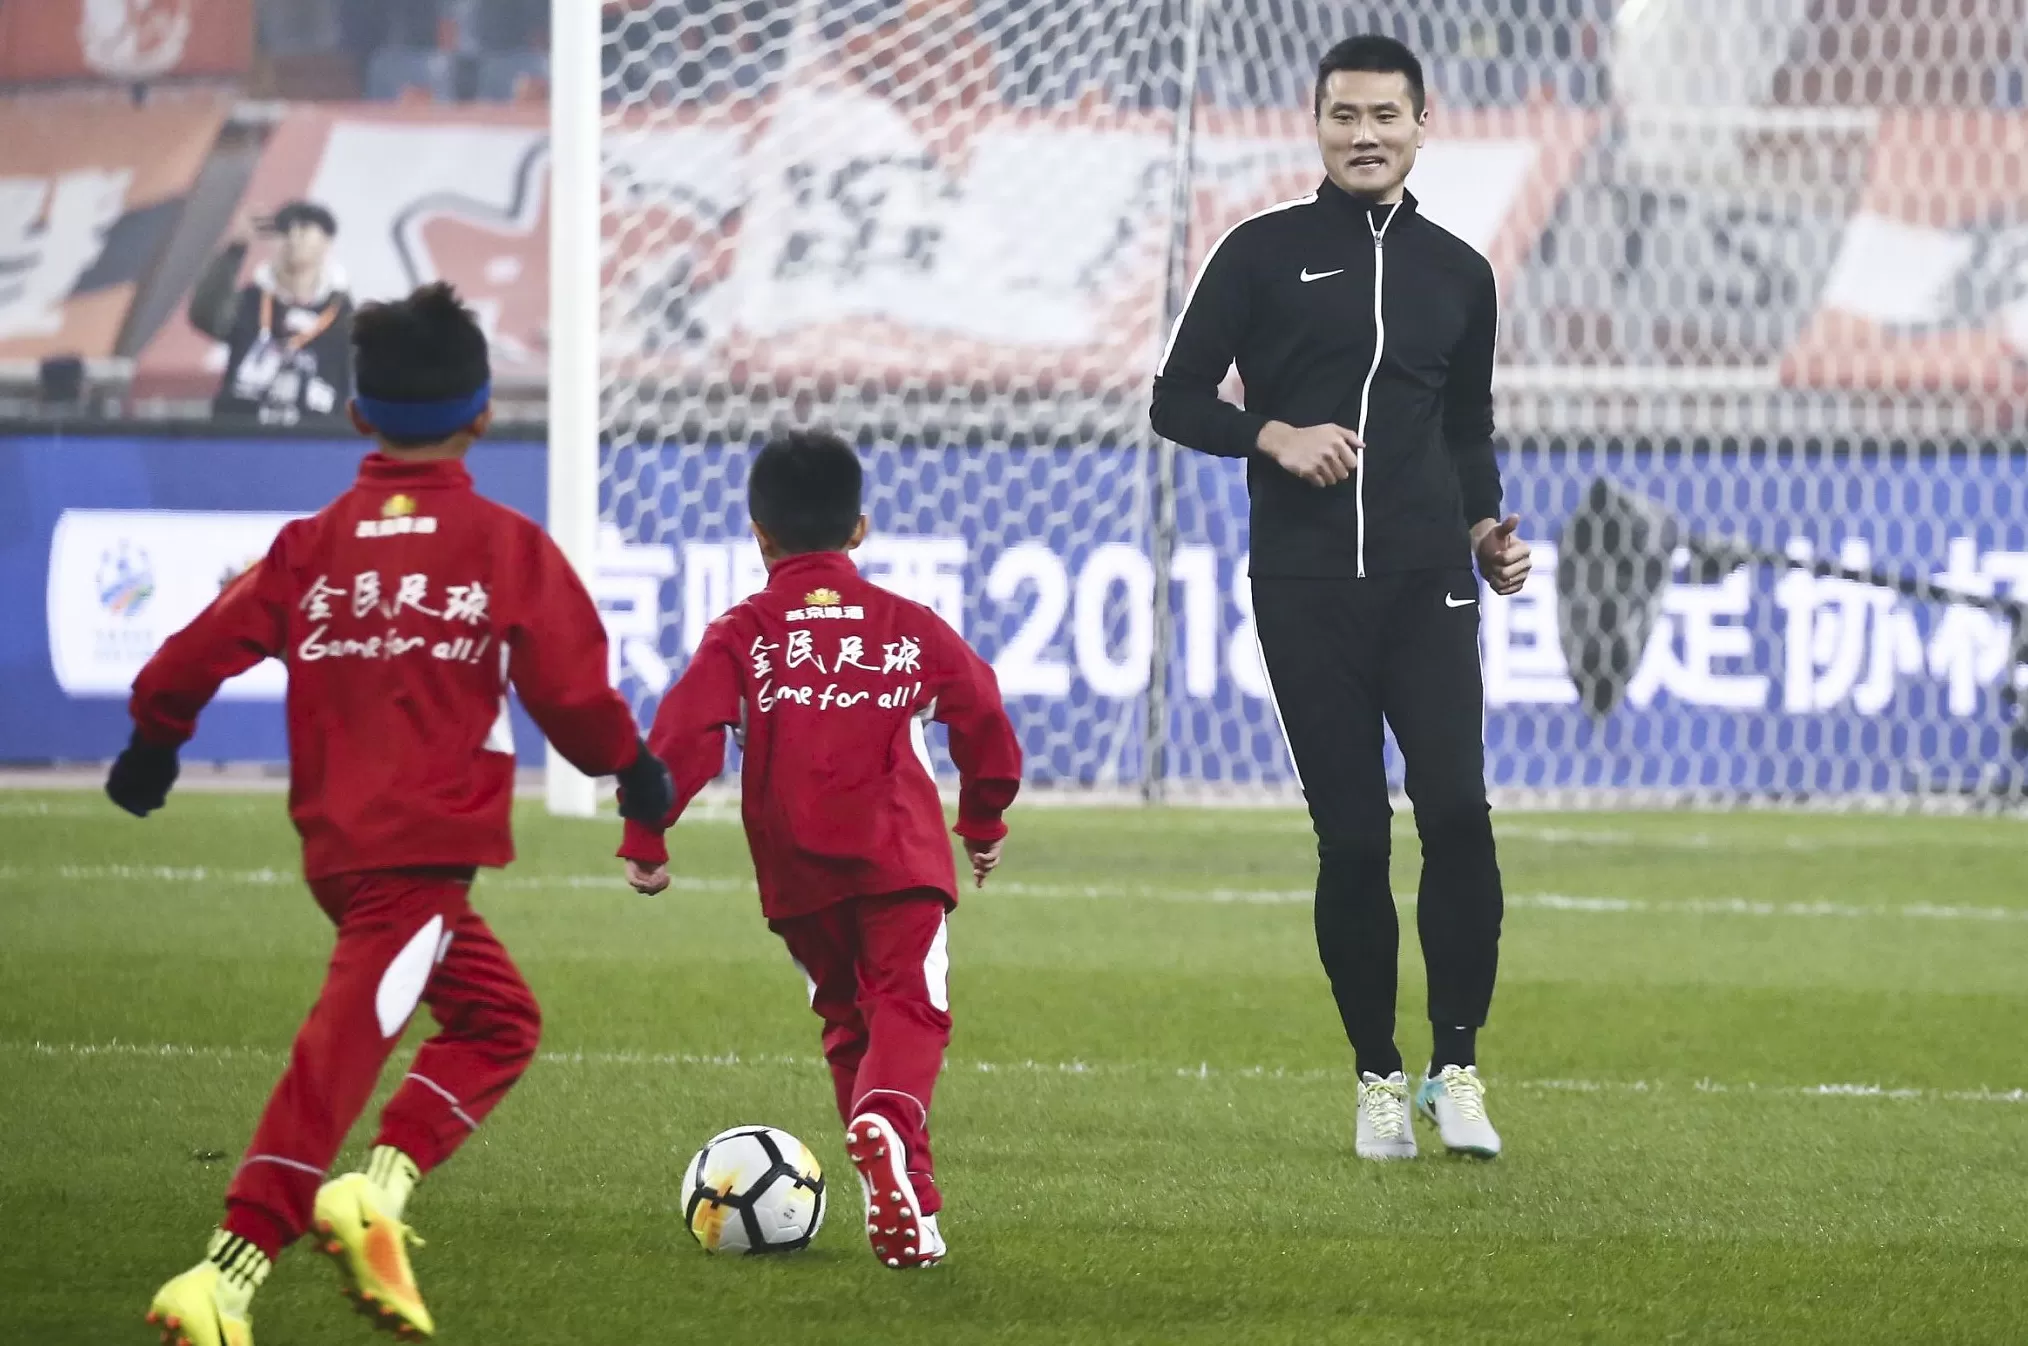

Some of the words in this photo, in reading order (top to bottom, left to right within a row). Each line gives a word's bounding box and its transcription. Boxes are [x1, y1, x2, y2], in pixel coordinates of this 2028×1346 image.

[300, 571, 490, 625] 全民足球
[750, 629, 921, 679] 全民足球
[757, 679, 813, 713] Gme
[818, 683, 870, 711] for
